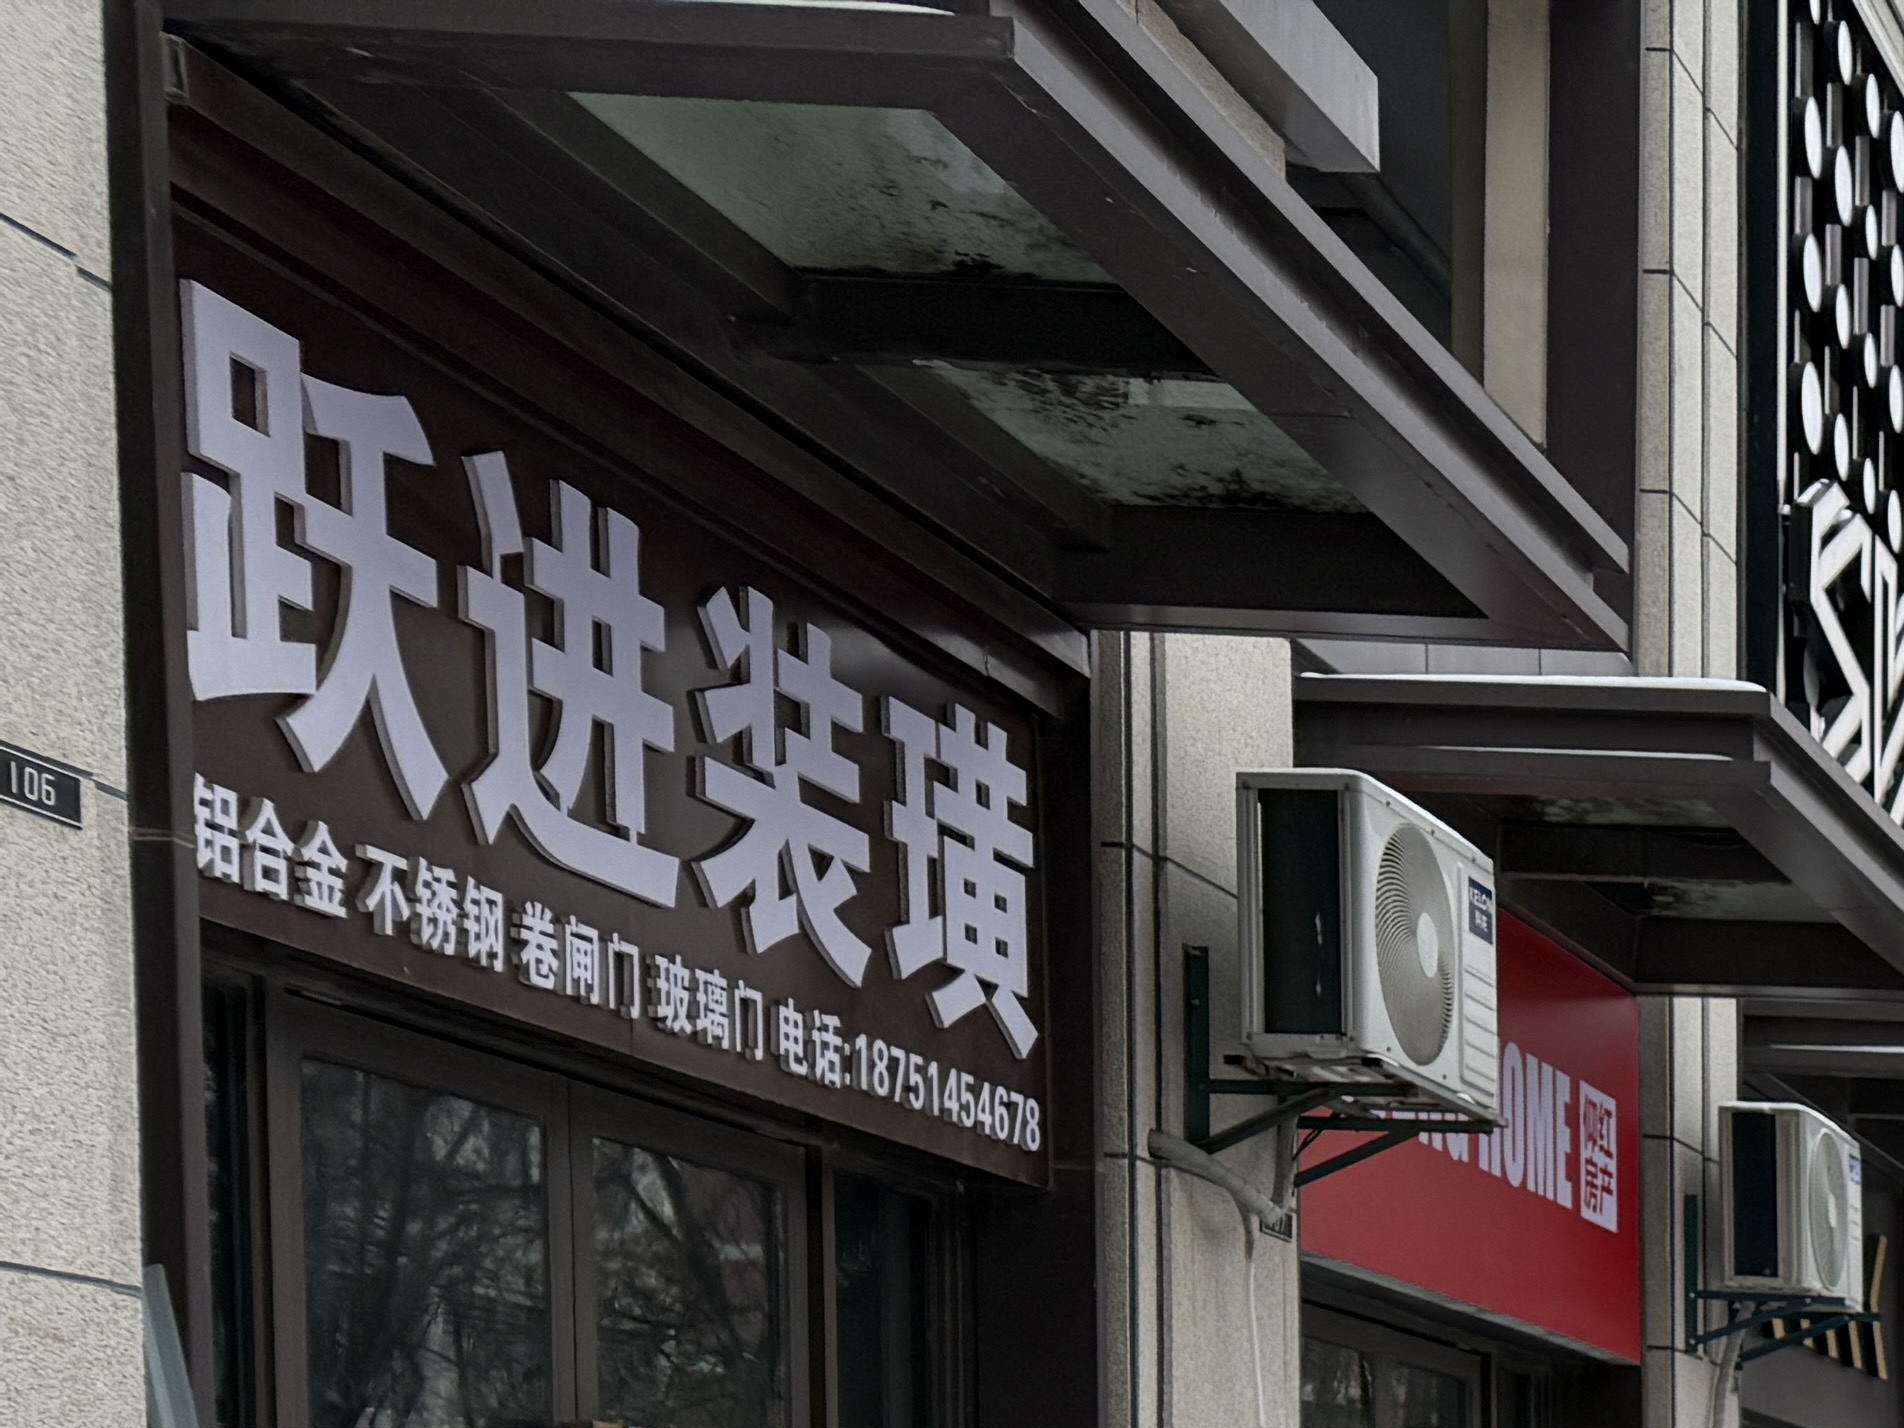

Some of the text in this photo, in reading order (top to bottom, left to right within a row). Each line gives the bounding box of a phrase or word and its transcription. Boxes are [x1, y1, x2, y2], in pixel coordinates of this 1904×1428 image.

[11, 760, 56, 806] 106
[180, 279, 1039, 1060] 跃进装璜
[194, 771, 1041, 1152] 铝合金 不锈钢 卷闸门 玻璃门 电话:18751454678
